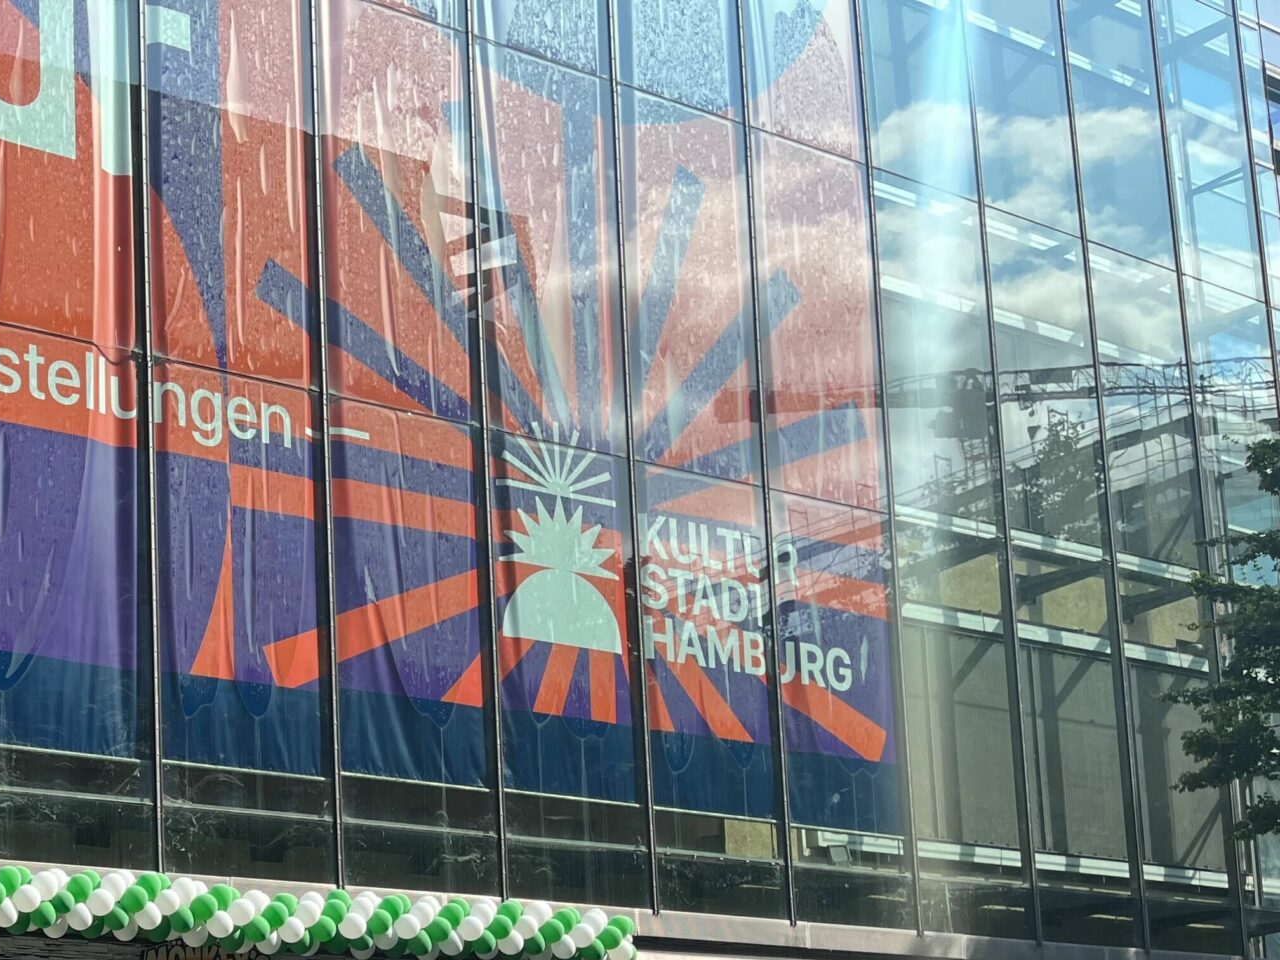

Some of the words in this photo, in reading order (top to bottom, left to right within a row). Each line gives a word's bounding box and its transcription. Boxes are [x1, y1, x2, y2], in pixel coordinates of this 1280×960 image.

[638, 512, 799, 587] KULTUR
[640, 563, 767, 627] STADT
[643, 615, 853, 691] HAMBURG
